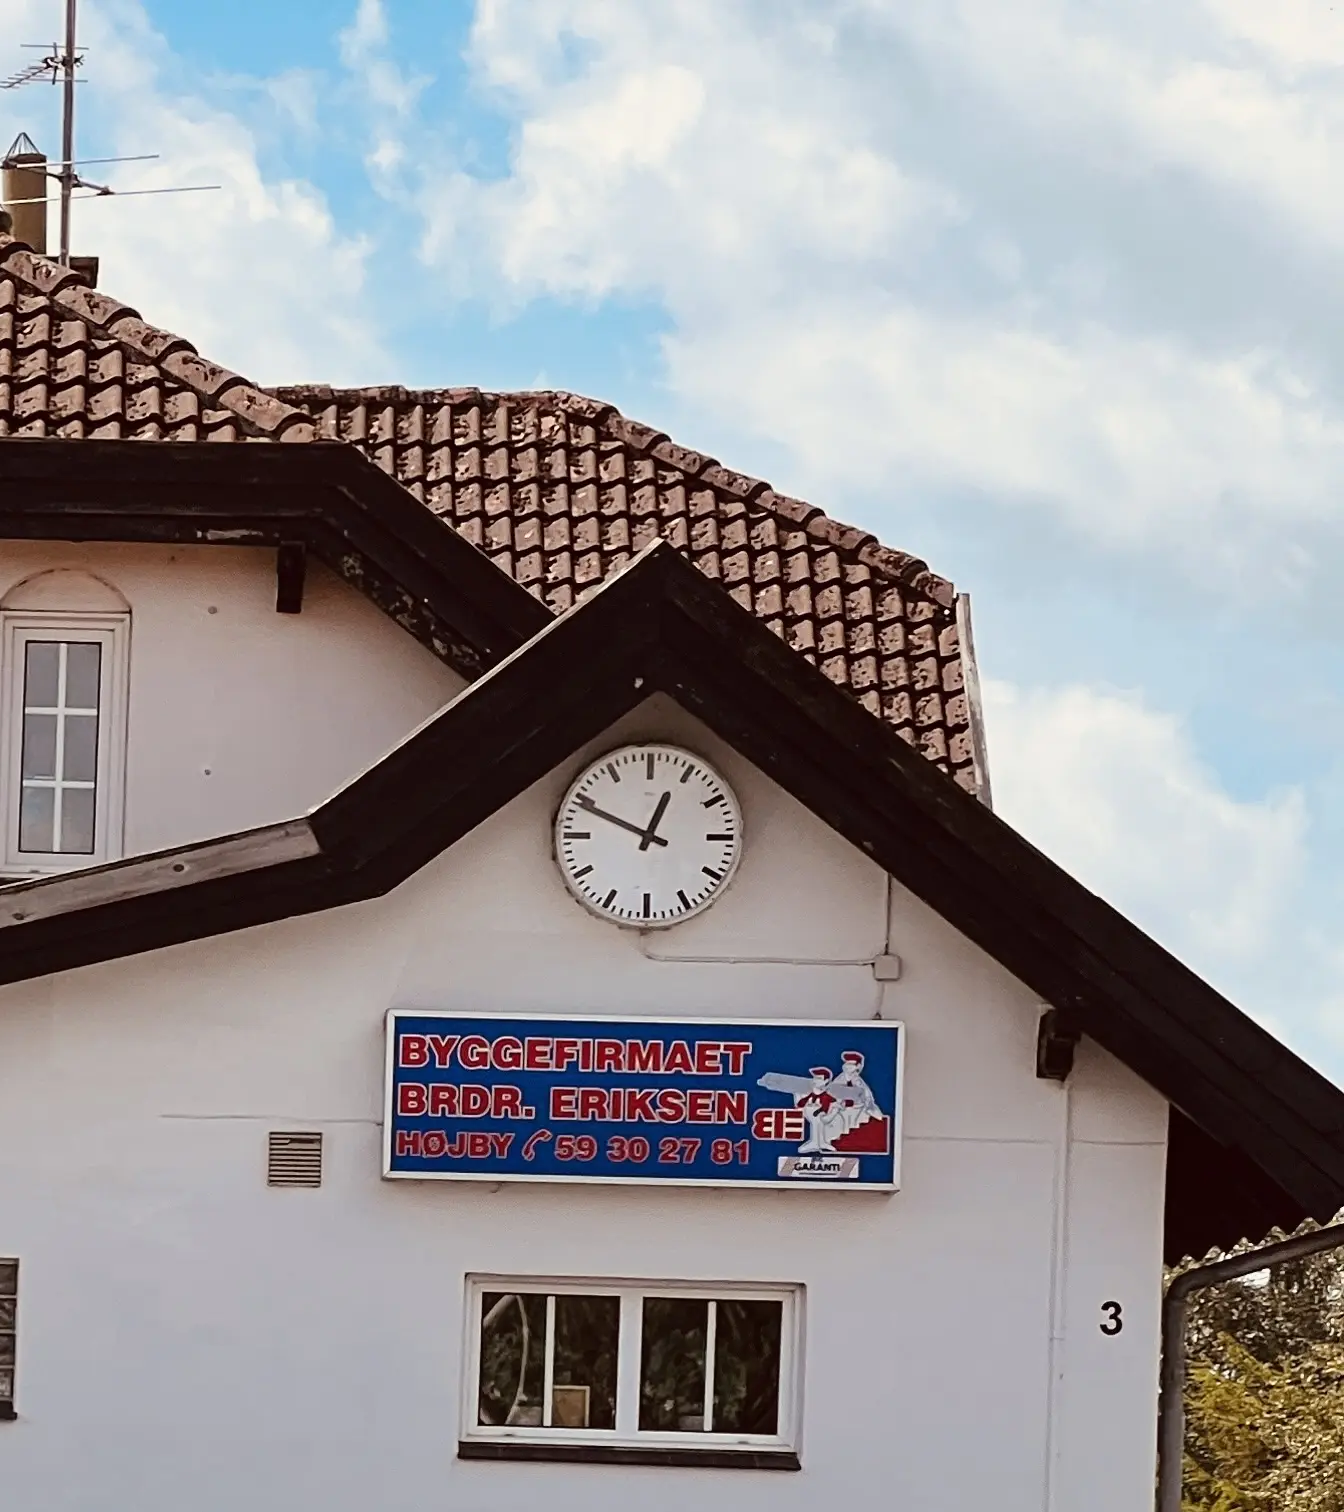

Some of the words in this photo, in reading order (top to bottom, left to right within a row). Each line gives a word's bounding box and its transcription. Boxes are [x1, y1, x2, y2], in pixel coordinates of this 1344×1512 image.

[399, 1034, 752, 1076] BYGGEFIRMAET
[397, 1082, 536, 1119] BRDR.
[549, 1087, 748, 1124] ERIKSEN
[395, 1130, 515, 1159] HØJBY
[554, 1135, 598, 1162] 59
[606, 1136, 650, 1164] 30
[658, 1137, 701, 1164] 27
[711, 1139, 750, 1165] 81
[793, 1162, 841, 1171] GARANTI
[1099, 1300, 1123, 1336] 3
